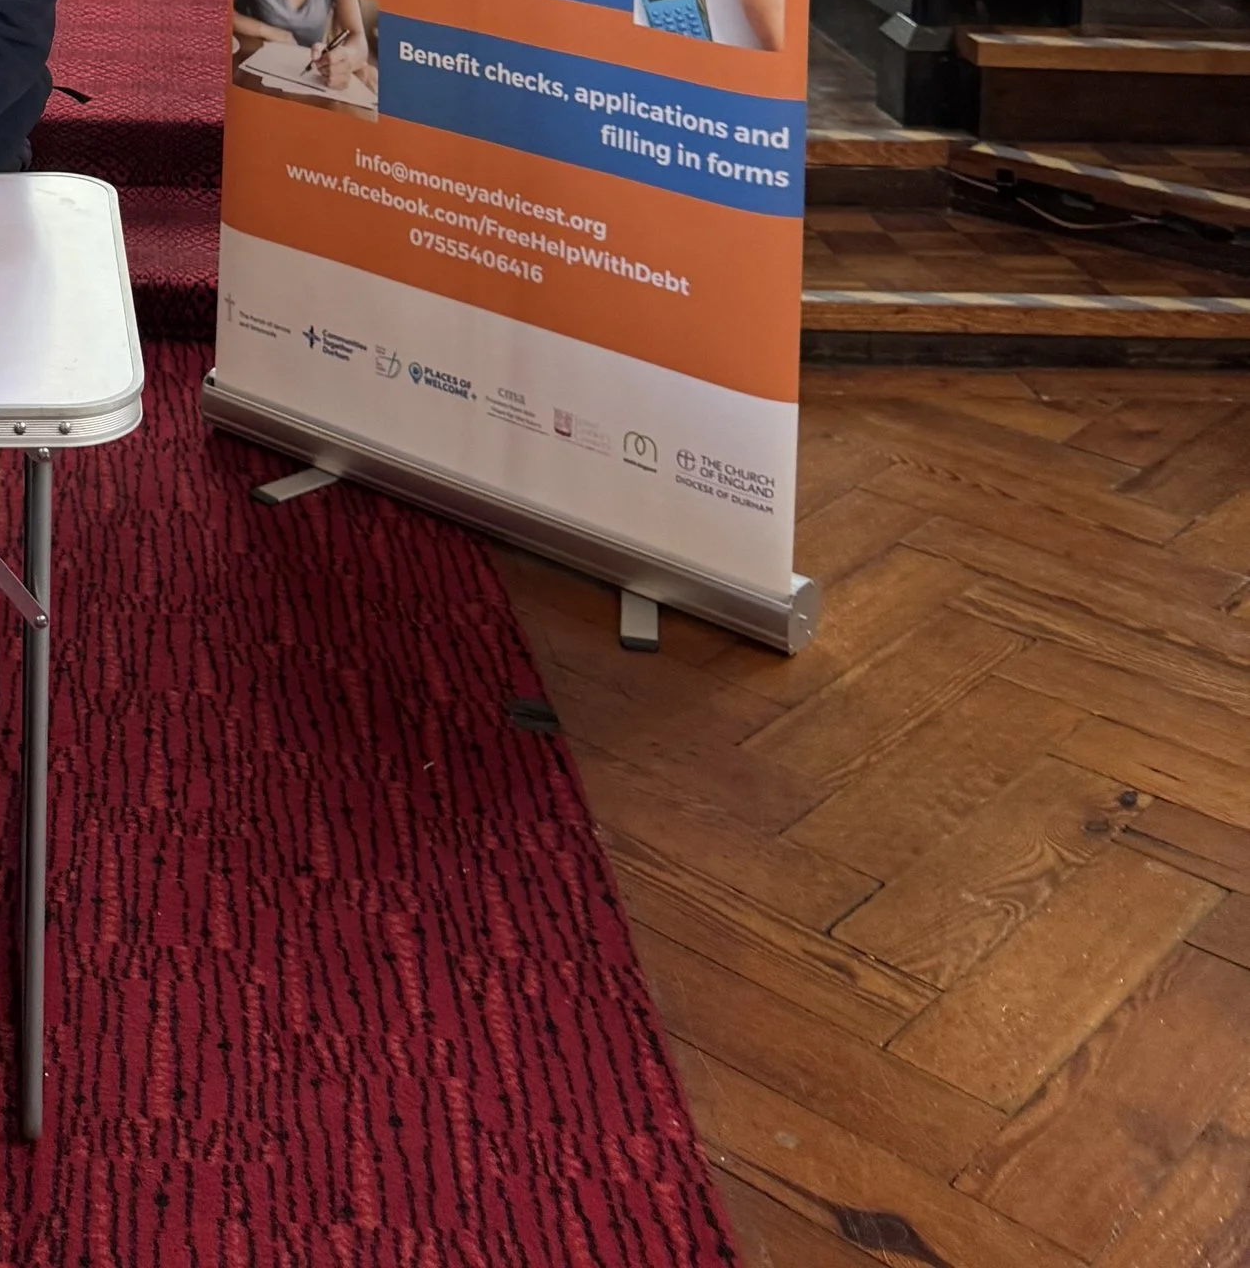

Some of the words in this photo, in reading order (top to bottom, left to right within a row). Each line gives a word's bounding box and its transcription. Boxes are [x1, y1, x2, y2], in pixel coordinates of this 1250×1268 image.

[399, 41, 480, 77] Benefit
[484, 63, 569, 101] checks,
[574, 83, 728, 139] applications
[734, 125, 789, 150] and
[600, 124, 671, 167] filling
[677, 142, 701, 170] in
[706, 152, 790, 188] forms
[355, 148, 607, 241] info@moneyadvicest.org
[286, 163, 690, 296] www.facebook.com/FreeHelpWithDebt
[409, 227, 543, 284] 07555406416
[424, 366, 458, 386] PLACES
[459, 378, 472, 389] OF
[424, 376, 469, 399] WELCOME
[675, 474, 714, 495] DIOCESE
[731, 494, 774, 515] DURHAM
[699, 466, 714, 479] OF
[717, 473, 774, 499] ENGLAND
[700, 454, 723, 472] THE
[724, 464, 775, 487] CHURCH
